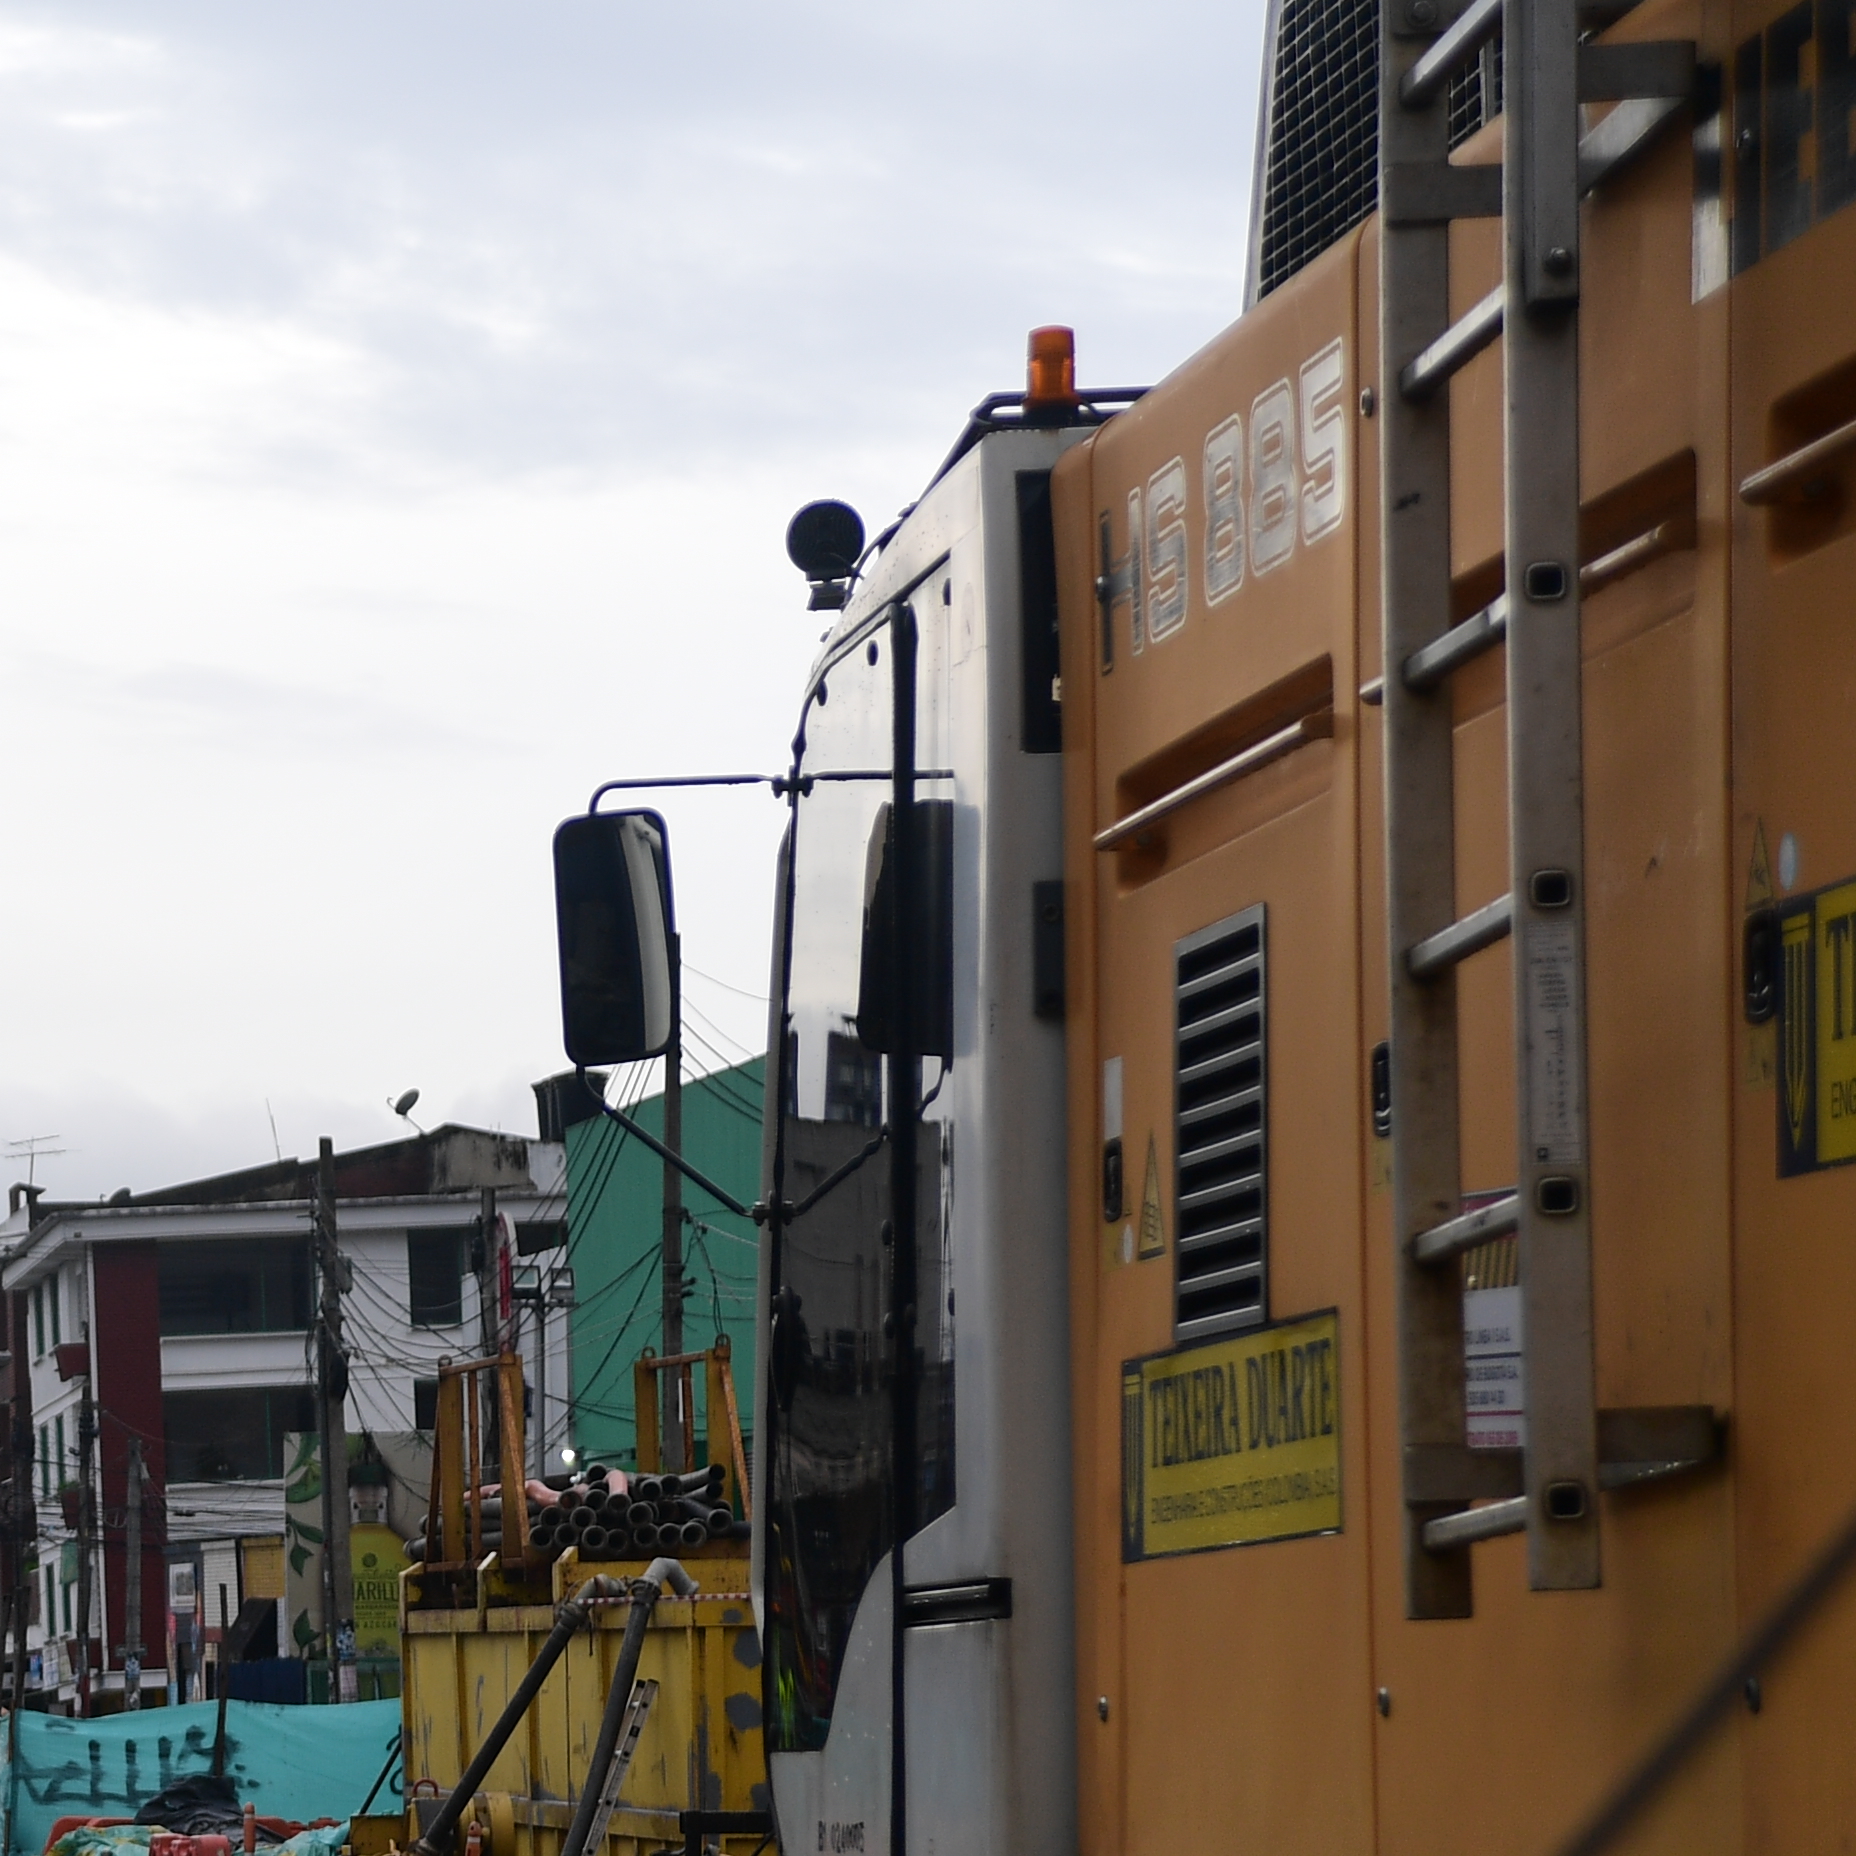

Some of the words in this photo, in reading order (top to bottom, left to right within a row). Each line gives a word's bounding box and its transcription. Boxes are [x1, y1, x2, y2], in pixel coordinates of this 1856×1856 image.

[1099, 455, 1188, 676] HS
[1203, 335, 1346, 608] 885
[1150, 1361, 1242, 1469] TEIXEIRA
[1245, 1337, 1332, 1450] DUARTE
